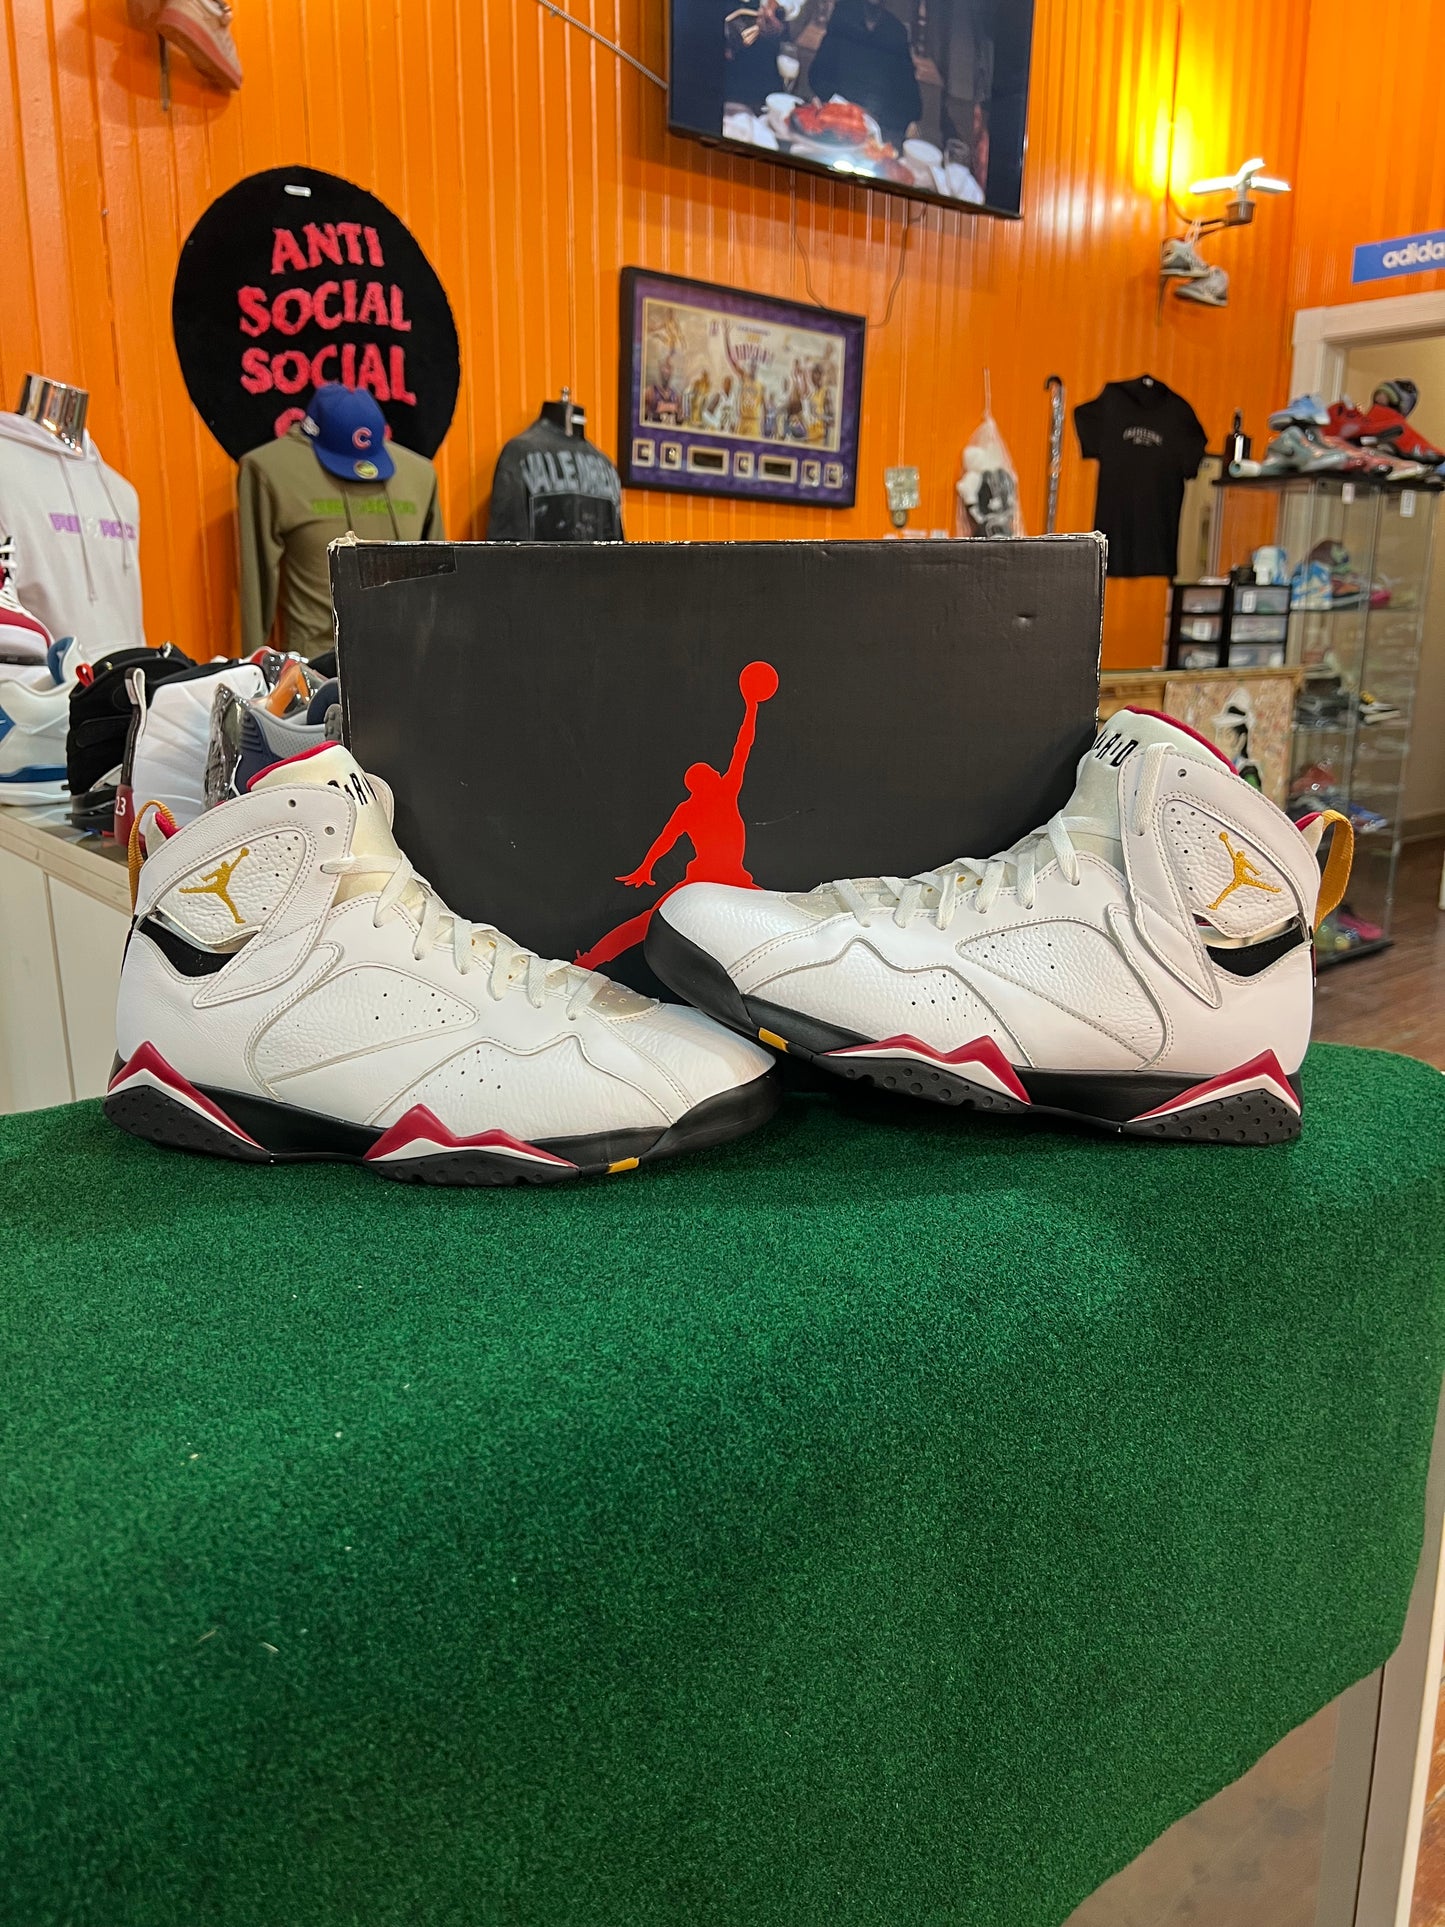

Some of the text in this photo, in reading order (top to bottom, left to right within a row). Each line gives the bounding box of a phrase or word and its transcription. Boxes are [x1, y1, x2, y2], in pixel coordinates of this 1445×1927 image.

[271, 222, 384, 275] ANTI
[1382, 240, 1445, 269] adida
[237, 279, 412, 338] SOCIAL
[240, 343, 418, 407] SOCIAL
[352, 427, 372, 449] C
[115, 795, 126, 816] 23
